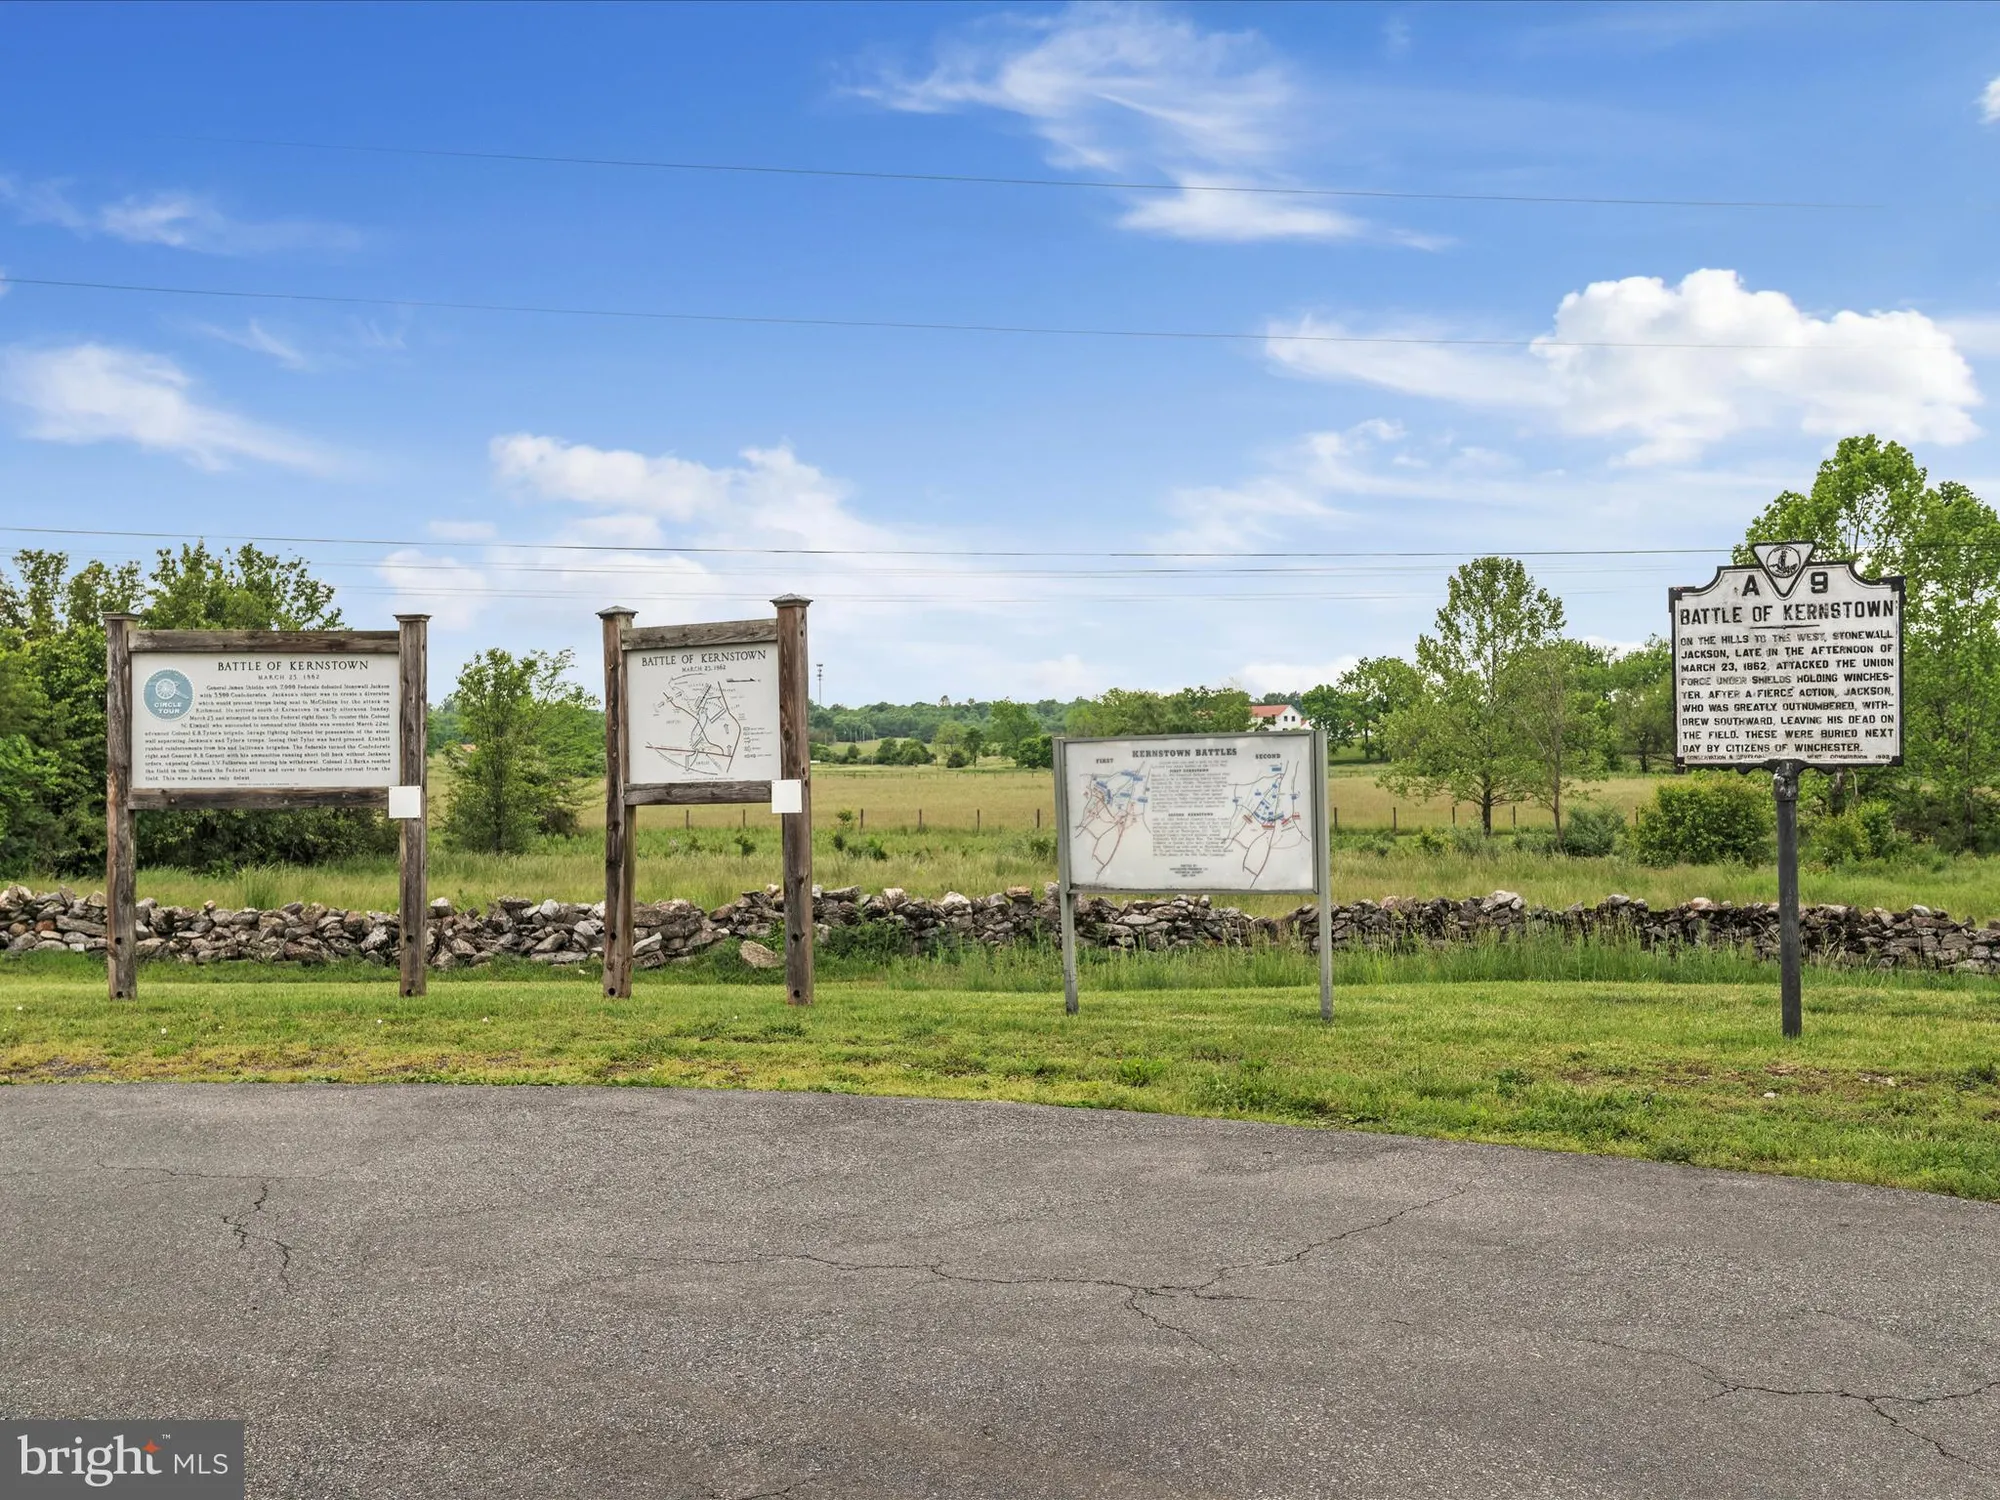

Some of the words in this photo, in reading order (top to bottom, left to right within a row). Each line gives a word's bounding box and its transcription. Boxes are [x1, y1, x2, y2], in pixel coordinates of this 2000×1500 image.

[1742, 575, 1760, 596] A
[1811, 572, 1828, 593] 9
[1680, 606, 1742, 625] BATTLE
[1752, 605, 1772, 622] OF
[1783, 600, 1894, 621] KERNSTOWN
[1680, 637, 1692, 646] ON
[1698, 636, 1716, 645] THE
[1721, 635, 1748, 644] HILLS
[1832, 630, 1893, 640] STONEWALL
[1681, 650, 1729, 659] JACKSON,
[1735, 649, 1761, 657] LATE
[1766, 648, 1778, 656] IN
[1784, 647, 1804, 656] THE
[1810, 645, 1873, 655] AFTERNOON
[1880, 644, 1893, 653] OF
[642, 656, 675, 666] BATTLE
[681, 654, 693, 664] OF
[700, 650, 765, 663] KERNSTOWN
[218, 661, 260, 671] BATTLE
[266, 661, 281, 671] OF
[290, 660, 368, 671] KERNSTOWN
[1680, 664, 1715, 672] MARCH
[1776, 660, 1828, 670] ATTACKED
[1835, 660, 1856, 668] THE
[1862, 658, 1893, 668] UNION
[1680, 677, 1710, 686] FORCE
[1751, 676, 1791, 684] SHIELDS
[1796, 674, 1837, 683] HOLDING
[1843, 673, 1893, 682] WINCHES-
[1745, 690, 1754, 698] A
[1757, 689, 1793, 698] FIERCE
[1682, 704, 1703, 712] WHO
[1708, 703, 1728, 712] WAS
[1734, 703, 1777, 712] GREATLY
[1862, 701, 1893, 710] WITH-
[1682, 717, 1709, 726] DREW
[1780, 716, 1821, 724] LEAVING
[1682, 731, 1701, 739] THE
[1744, 730, 1777, 738] THESE
[1784, 730, 1813, 738] WERE
[1820, 729, 1857, 738] BURIED
[1865, 729, 1893, 737] NEXT
[1132, 749, 1190, 758] KERNSTOWN
[1195, 748, 1236, 757] BATTLES
[1682, 744, 1700, 752] DAY
[1706, 744, 1719, 752] BY
[1725, 744, 1769, 752] CITIZENS
[1774, 744, 1787, 752] OF
[1794, 743, 1862, 752] WINCHESTER.
